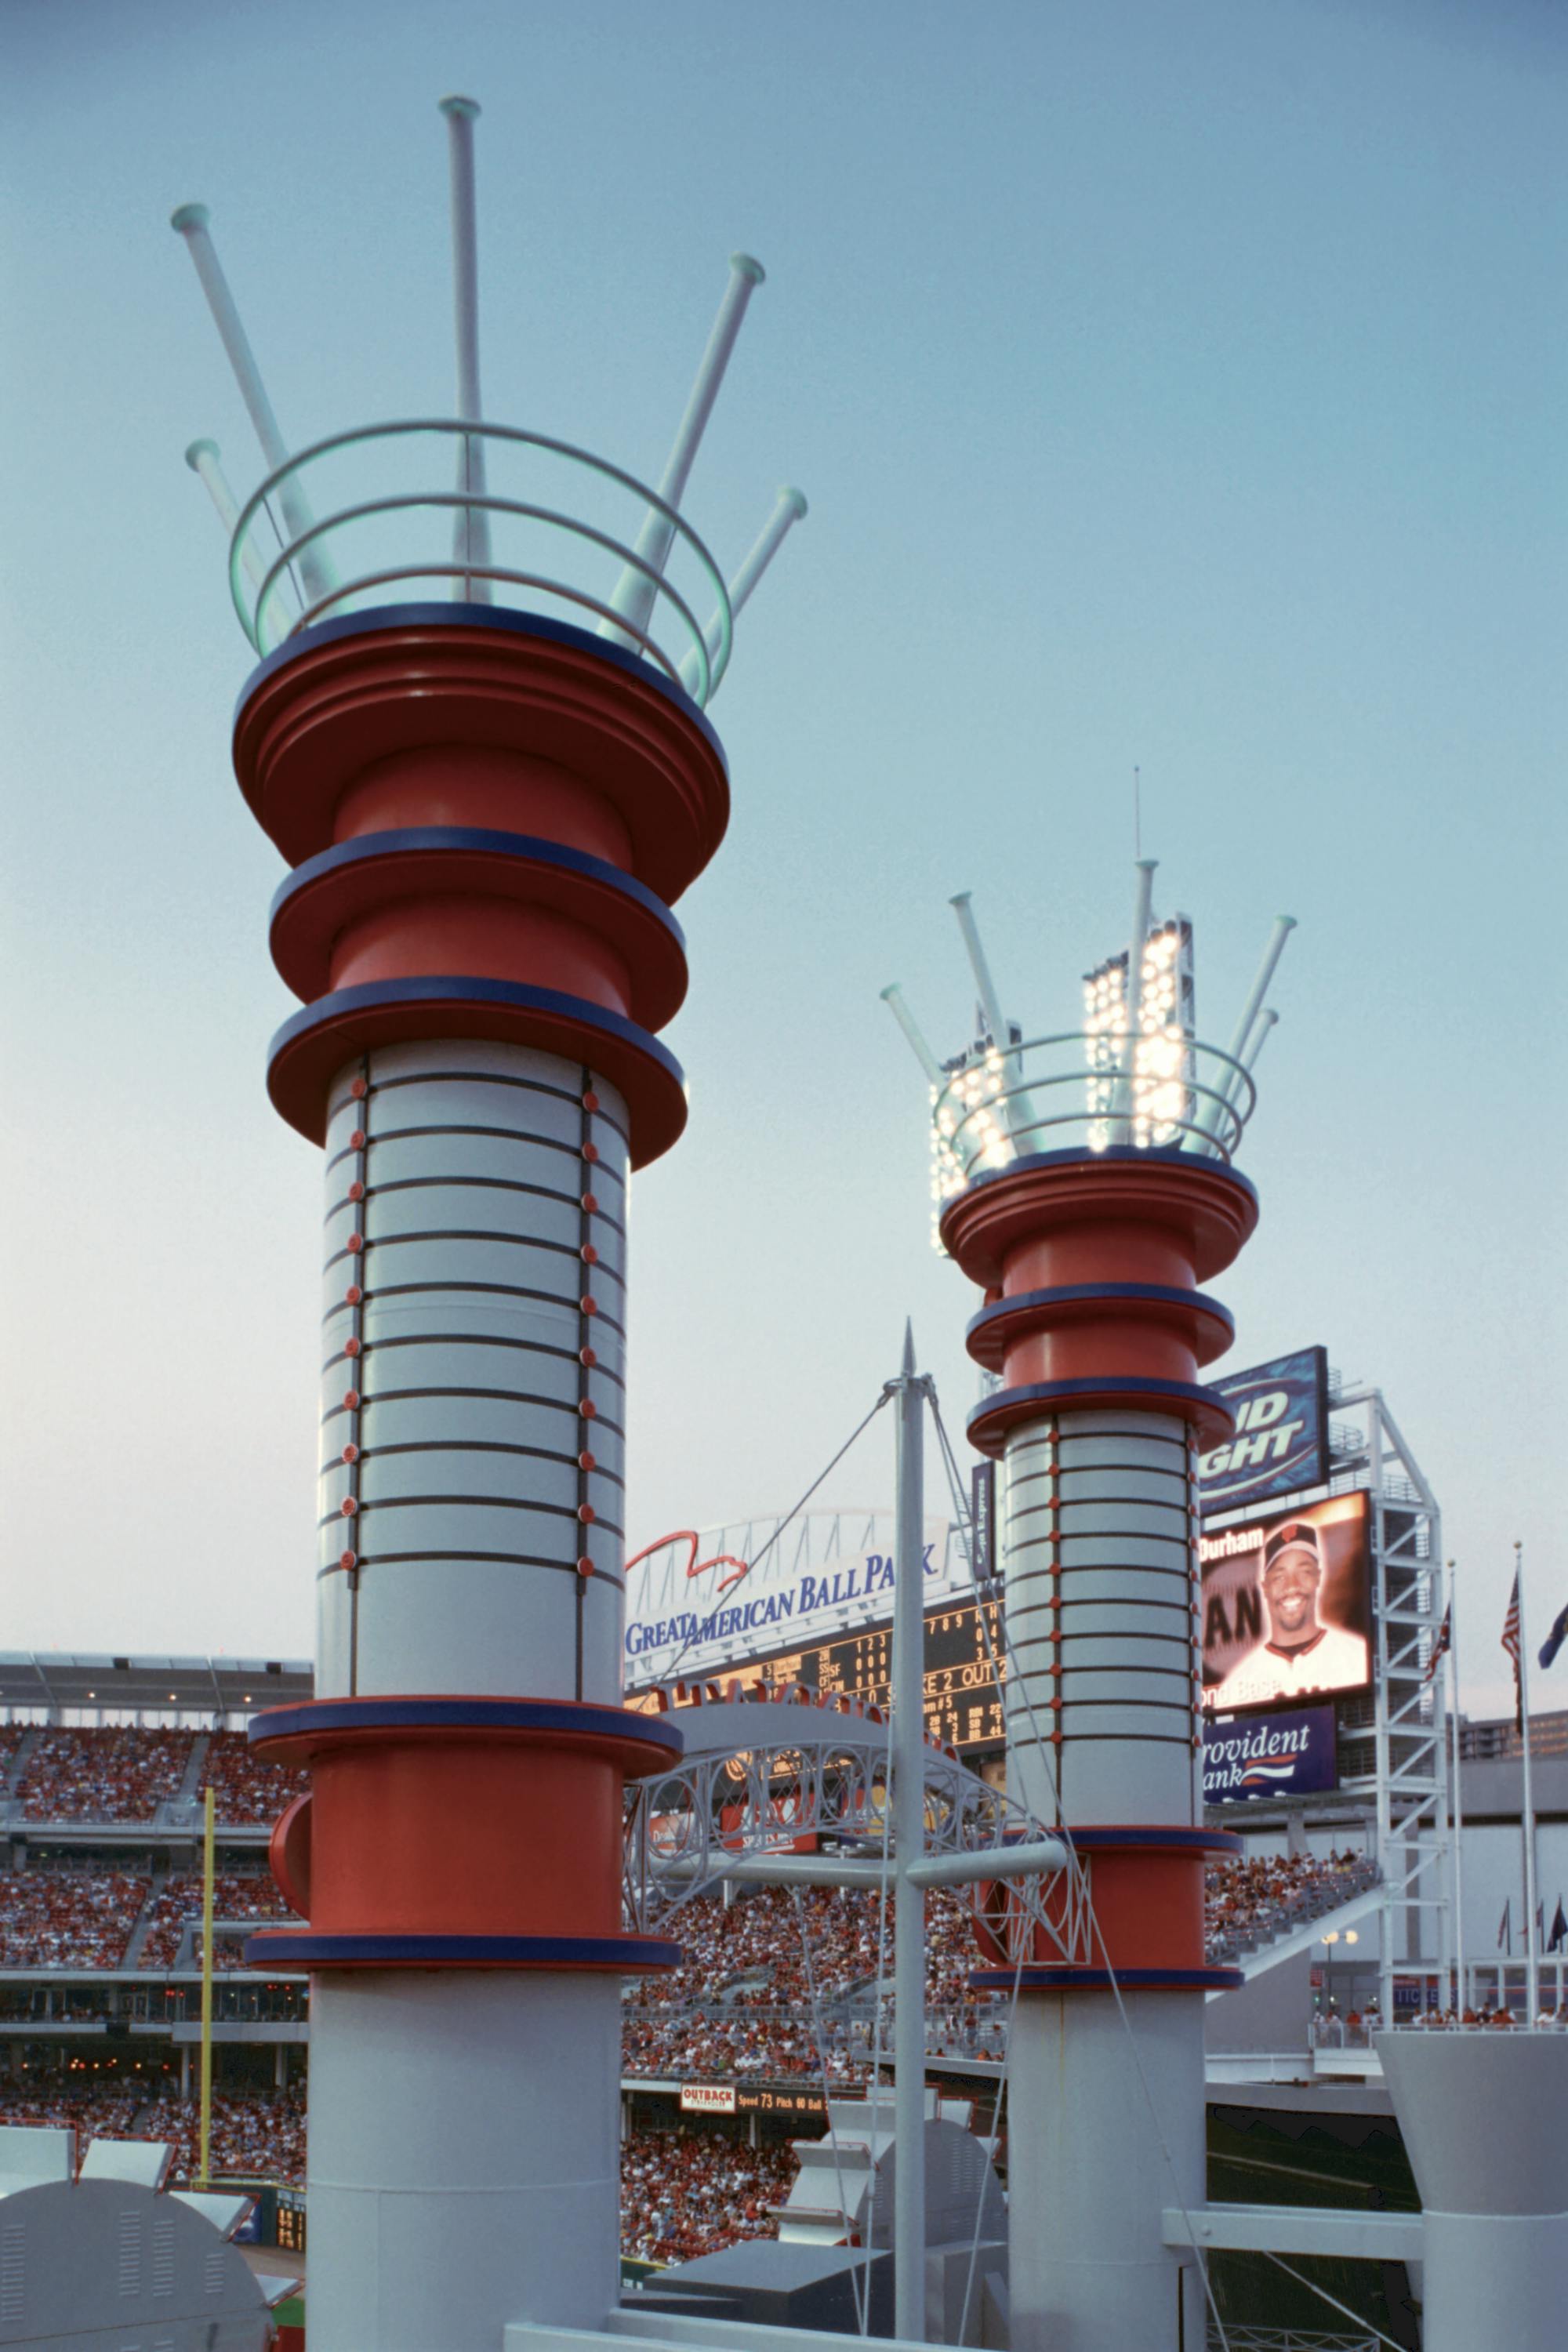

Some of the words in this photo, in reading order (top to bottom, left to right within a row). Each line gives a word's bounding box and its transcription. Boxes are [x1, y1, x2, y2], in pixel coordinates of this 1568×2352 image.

[1197, 1420, 1303, 1478] GHT
[1199, 1528, 1264, 1562] Durham
[626, 1613, 691, 1655] GREAT
[683, 1588, 795, 1649] AMERICAN
[798, 1568, 862, 1614] BALL
[863, 1544, 938, 1595] PAK
[857, 1640, 862, 1653] 1
[868, 1637, 873, 1650] 2
[880, 1634, 886, 1647] 3
[930, 1621, 936, 1635] 7
[942, 1617, 949, 1632] 8
[956, 1614, 962, 1628] 9
[989, 1606, 997, 1620] H
[831, 1663, 841, 1677] SF
[856, 1657, 862, 1671] 0
[868, 1655, 873, 1668] 0
[880, 1652, 886, 1665] 0
[975, 1628, 982, 1642] 0
[991, 1624, 997, 1638] 4
[856, 1675, 862, 1688] 0
[868, 1672, 874, 1686] 0
[880, 1670, 886, 1683] 0
[977, 1647, 982, 1661] 3
[991, 1644, 997, 1657] 5
[944, 1672, 952, 1690] 2
[962, 1664, 993, 1686] OUT
[999, 1661, 1007, 1679] 2
[1203, 1726, 1310, 1763] rovident
[1203, 1763, 1243, 1791] ank
[684, 2089, 732, 2102] OUTBACK
[739, 2094, 758, 2107] Speed
[760, 2092, 772, 2108] 73
[776, 2095, 793, 2108] Pitch
